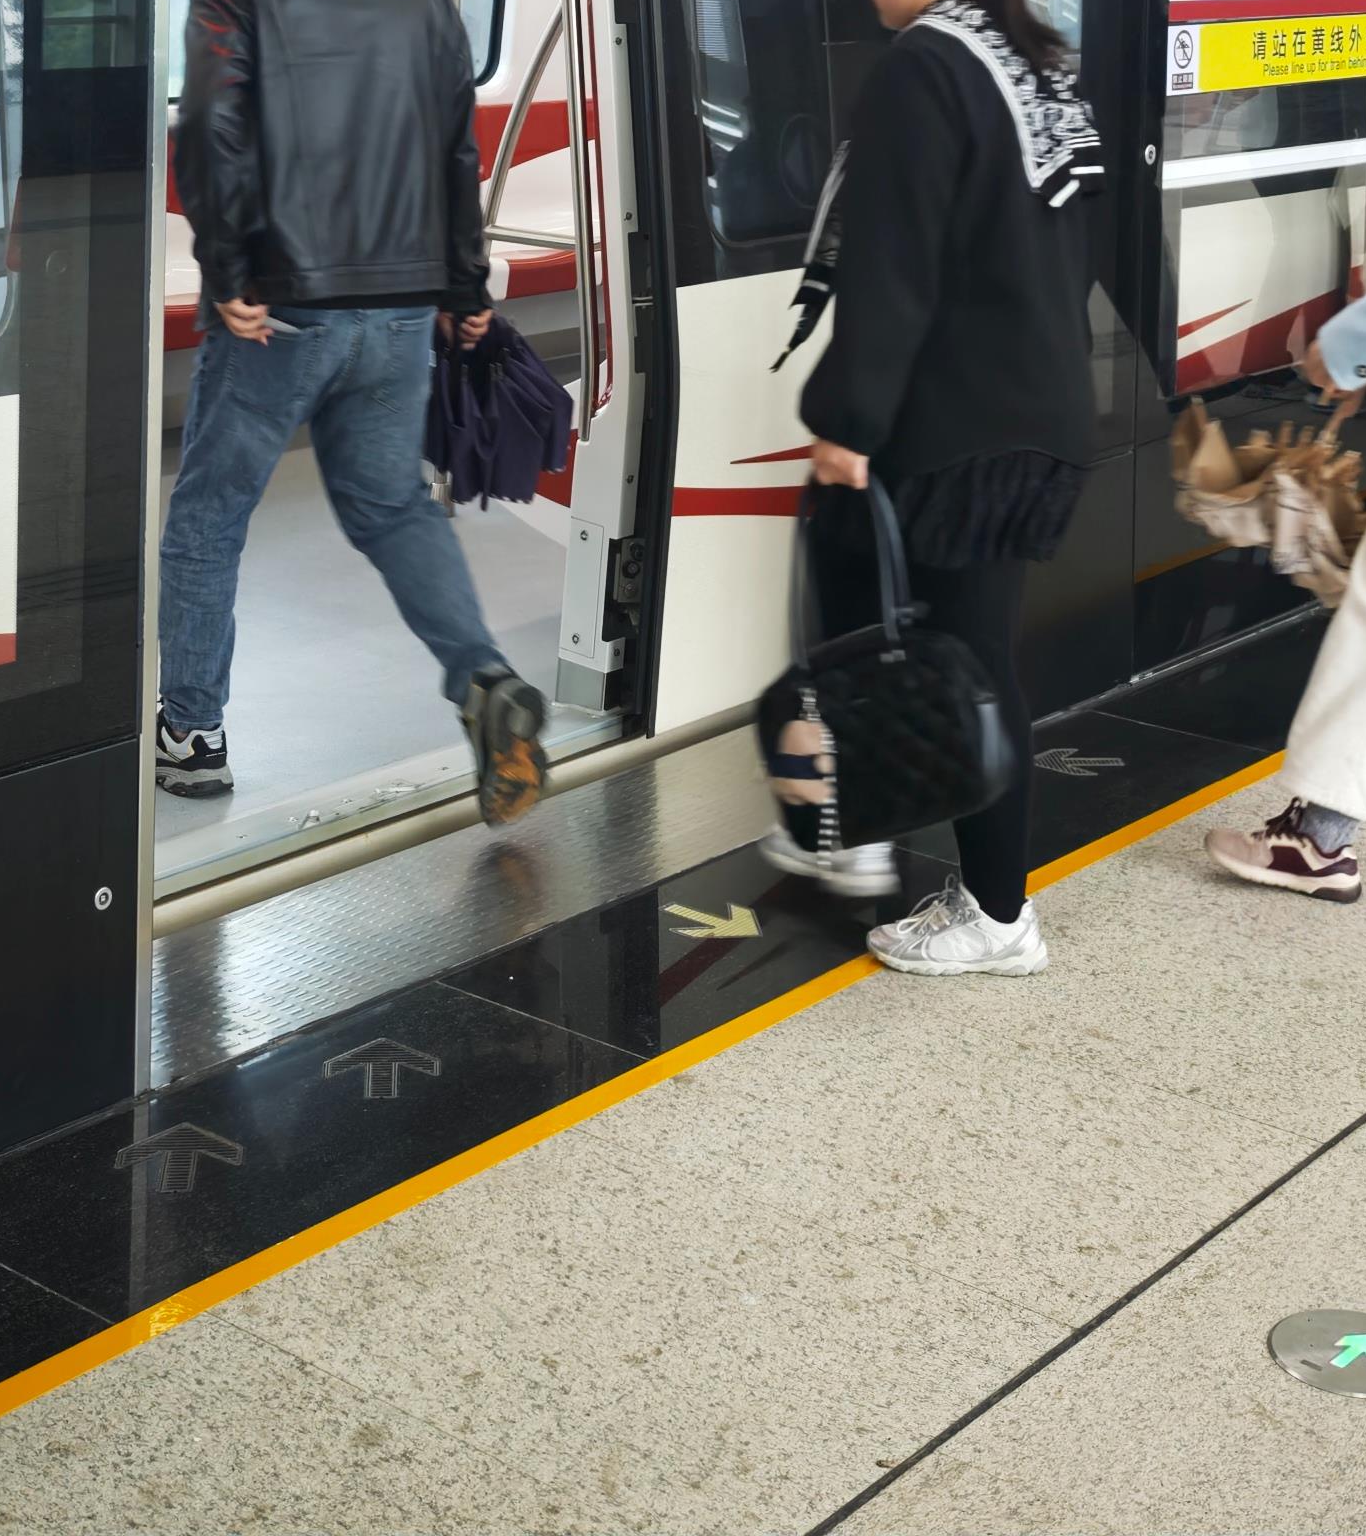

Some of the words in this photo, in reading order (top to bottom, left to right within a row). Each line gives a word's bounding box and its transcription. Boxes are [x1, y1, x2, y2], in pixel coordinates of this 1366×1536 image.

[1263, 62, 1288, 76] Please
[1291, 62, 1305, 74] line
[1306, 63, 1316, 76] up
[1318, 60, 1329, 72] for
[1330, 59, 1347, 71] train
